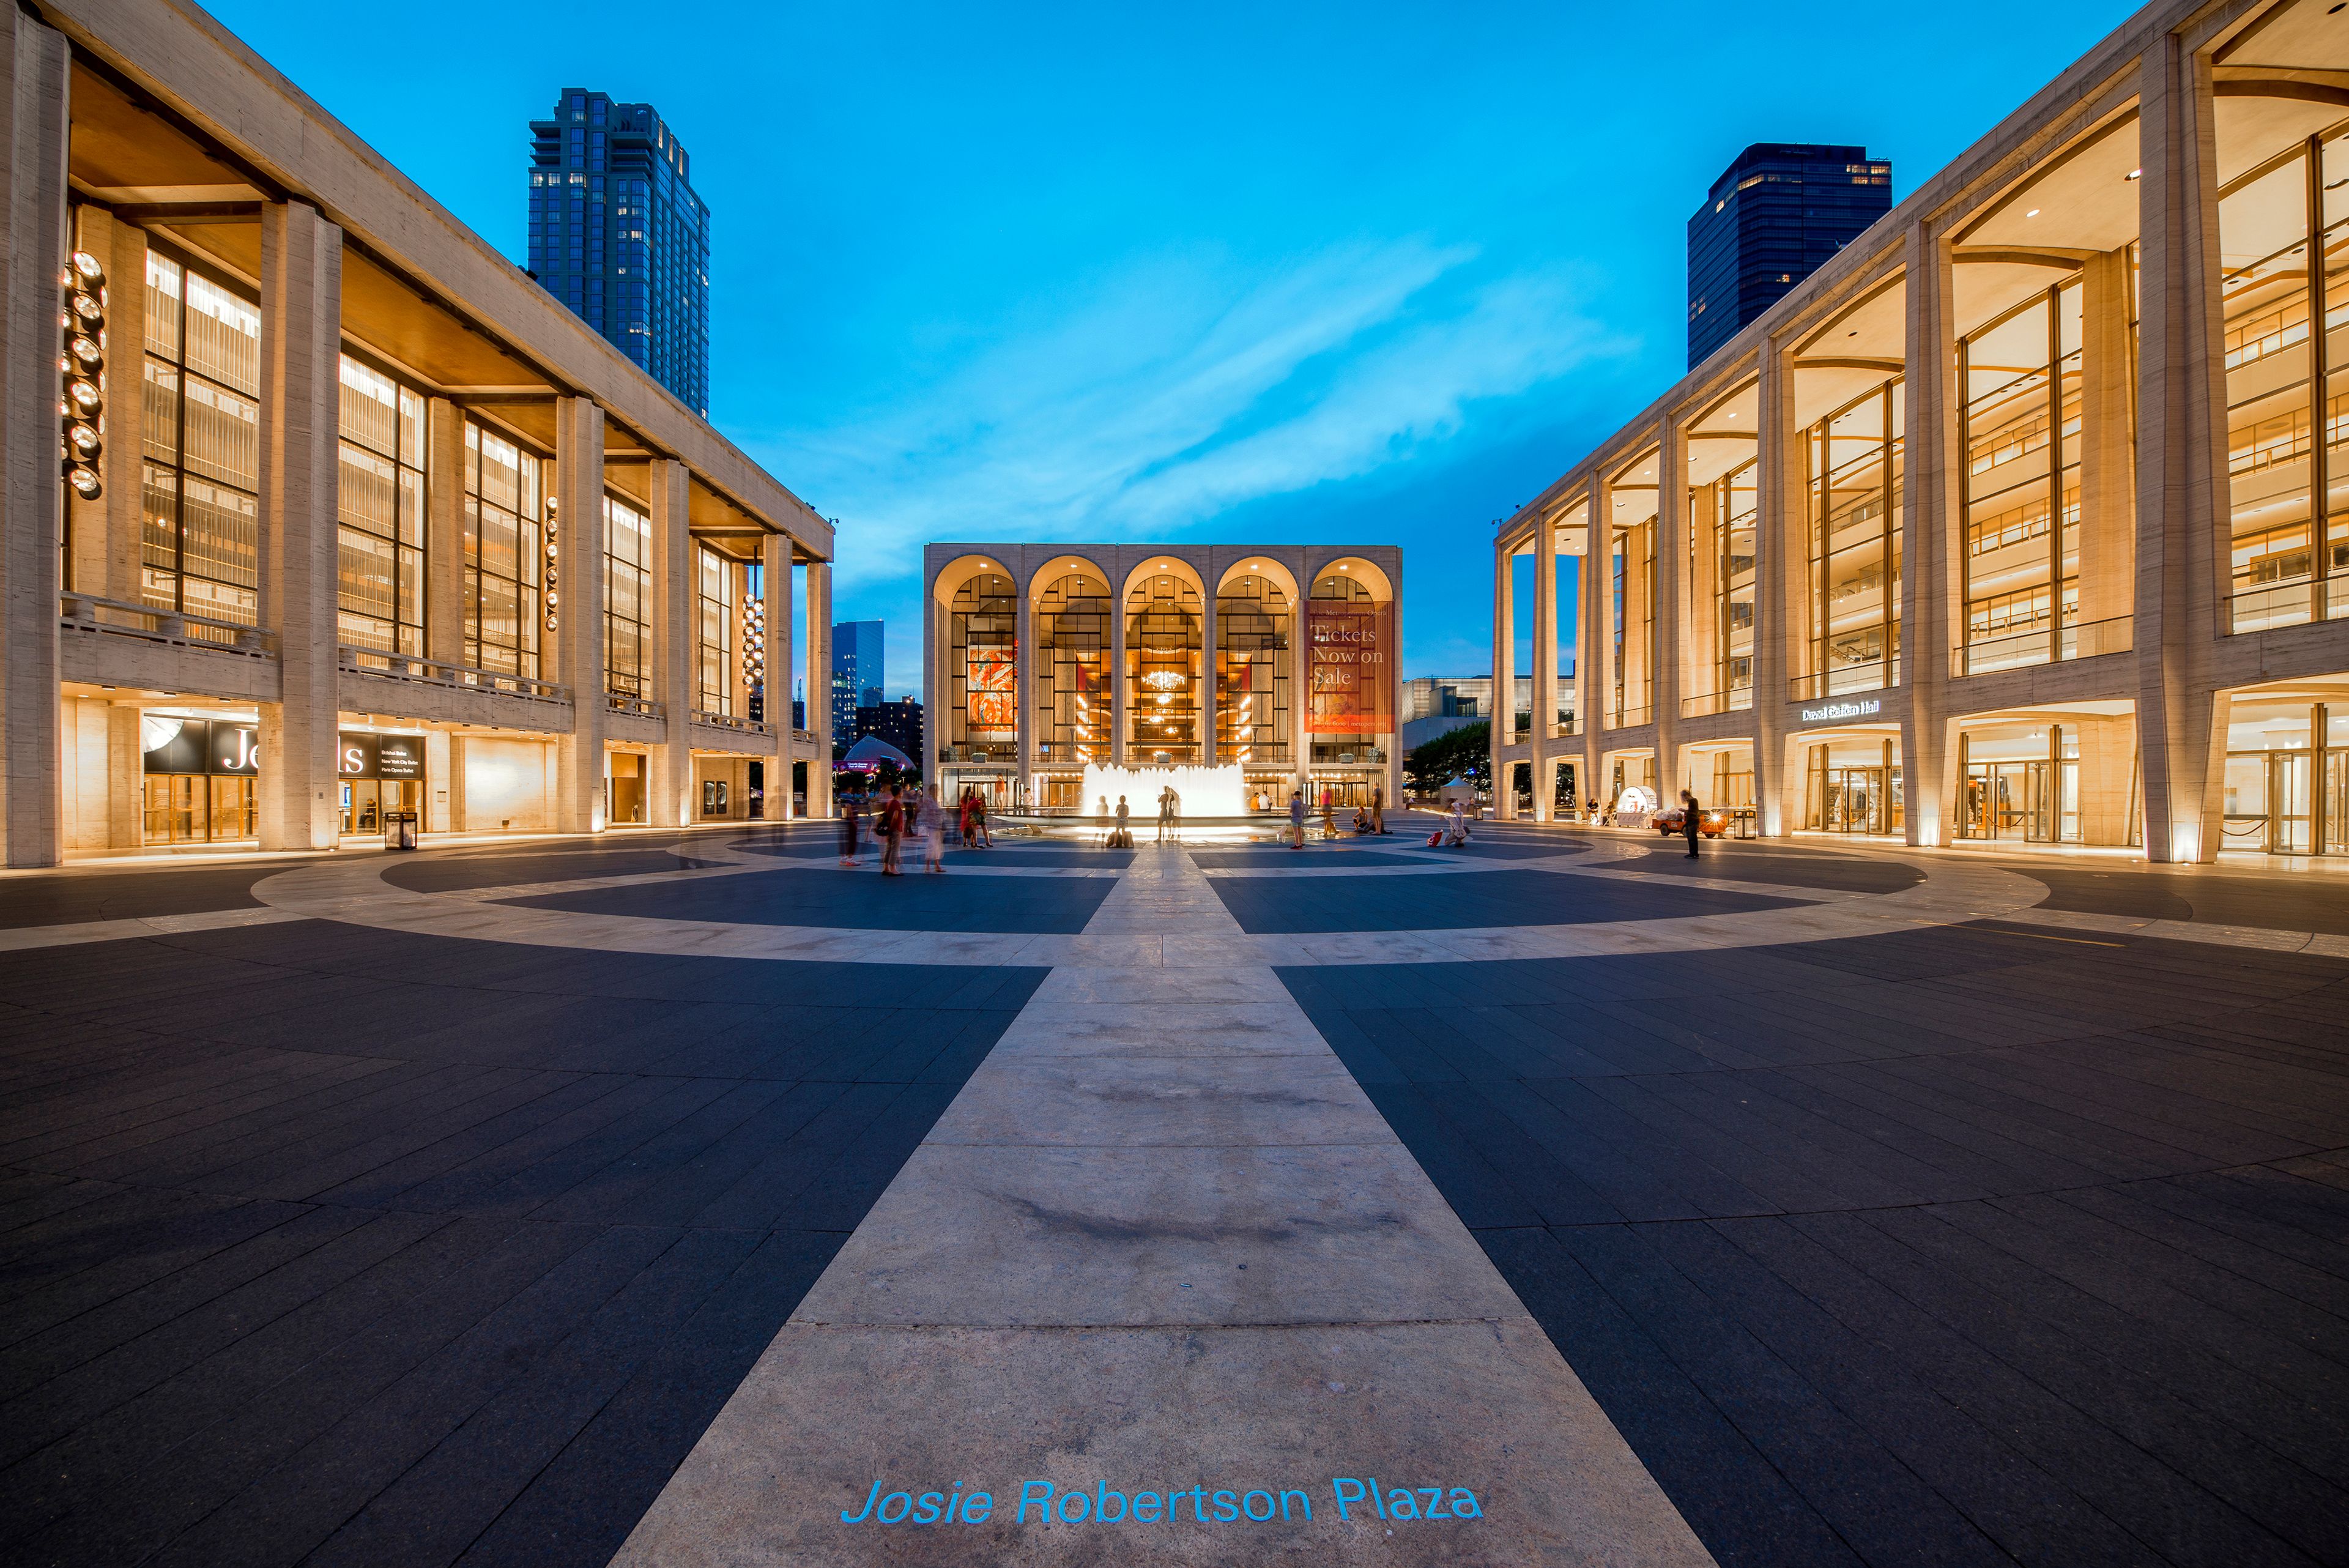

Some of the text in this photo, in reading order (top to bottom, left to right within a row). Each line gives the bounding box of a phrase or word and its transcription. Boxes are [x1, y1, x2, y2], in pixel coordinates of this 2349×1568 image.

[1310, 625, 1376, 642] Tickets
[1312, 646, 1384, 663] Now on
[1313, 667, 1351, 685] Sale
[1802, 700, 1880, 721] David Geffen Hall
[841, 1478, 1483, 1523] Josie Robertson Plaza
